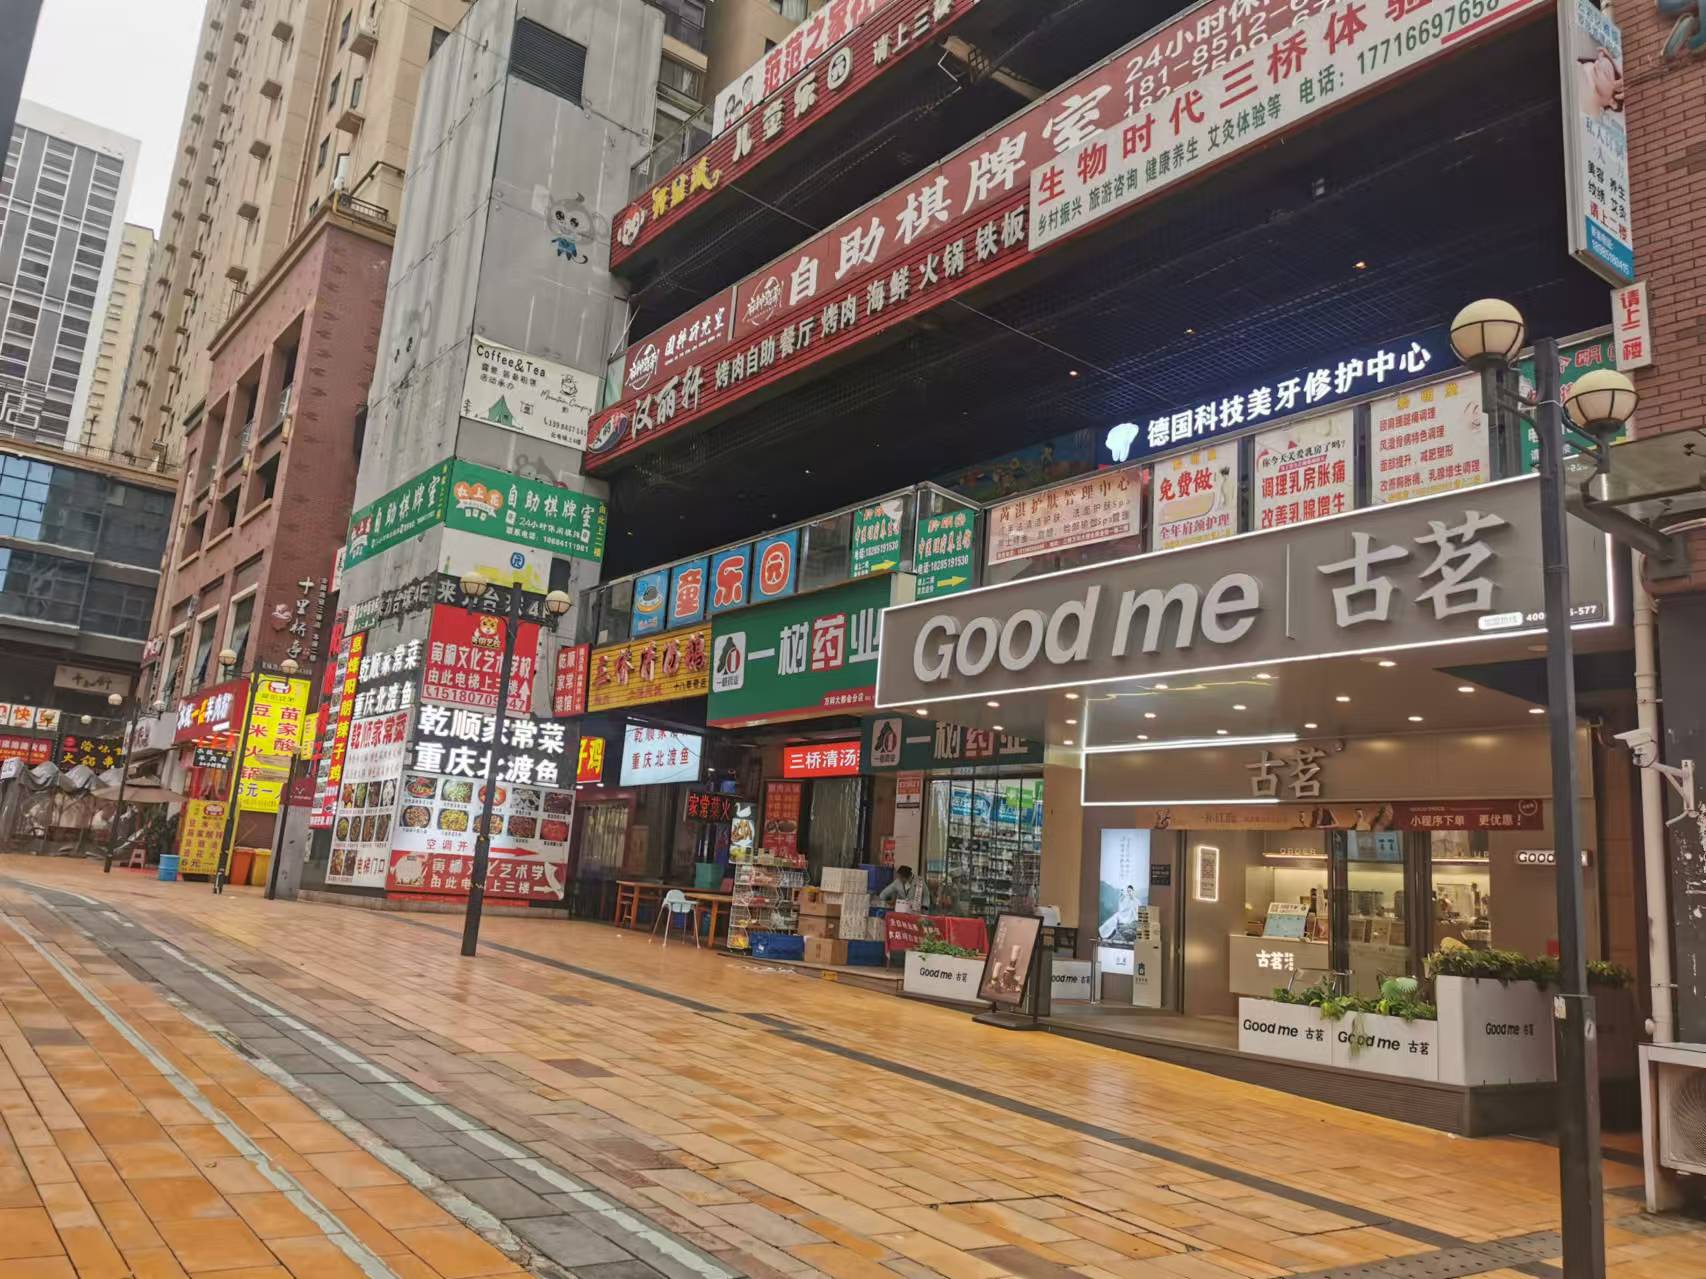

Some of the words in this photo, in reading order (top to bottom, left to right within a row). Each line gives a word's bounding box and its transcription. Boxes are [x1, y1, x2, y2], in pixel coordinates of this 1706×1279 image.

[1124, 0, 1270, 83] 24小时休
[732, 47, 853, 163] 儿童乐园
[1037, 186, 1083, 237] 乡村振兴
[1088, 165, 1139, 213] 旅游咨询
[1145, 136, 1200, 184] 健康养生
[1207, 93, 1283, 152] 艾灸体验等
[789, 83, 1113, 306] 自助棋牌室
[1620, 288, 1644, 362] 请上二楼
[476, 343, 547, 378] Coffee&Tea
[1147, 341, 1432, 449] 德国科技美牙修护中心
[1159, 467, 1213, 502] 免费做
[1261, 459, 1346, 499] 调理乳房胀痛
[507, 484, 596, 529] 自助棋牌室
[674, 541, 792, 619] 童乐园
[1318, 510, 1506, 629] 古茗
[747, 608, 881, 675] 一树药业
[913, 585, 1101, 683] Good
[1111, 572, 1260, 658] me
[434, 686, 526, 709] 1518070947
[417, 704, 566, 755] 乾顺家常菜
[631, 747, 690, 770] 重庆北渡鱼
[789, 747, 861, 770] 三桥清汤
[1245, 748, 1326, 800] 古茗
[1410, 814, 1465, 828] 小程序下单
[430, 873, 531, 895] 由此电上三楼
[920, 967, 939, 978] Good
[940, 971, 953, 980] me
[1243, 1018, 1276, 1036] Good
[1278, 1023, 1299, 1038] me
[1305, 1027, 1325, 1042] 古茗
[1377, 1036, 1401, 1051] me
[1408, 1040, 1430, 1055] 古茗
[1485, 1022, 1507, 1036] Good
[1507, 1025, 1521, 1036] me
